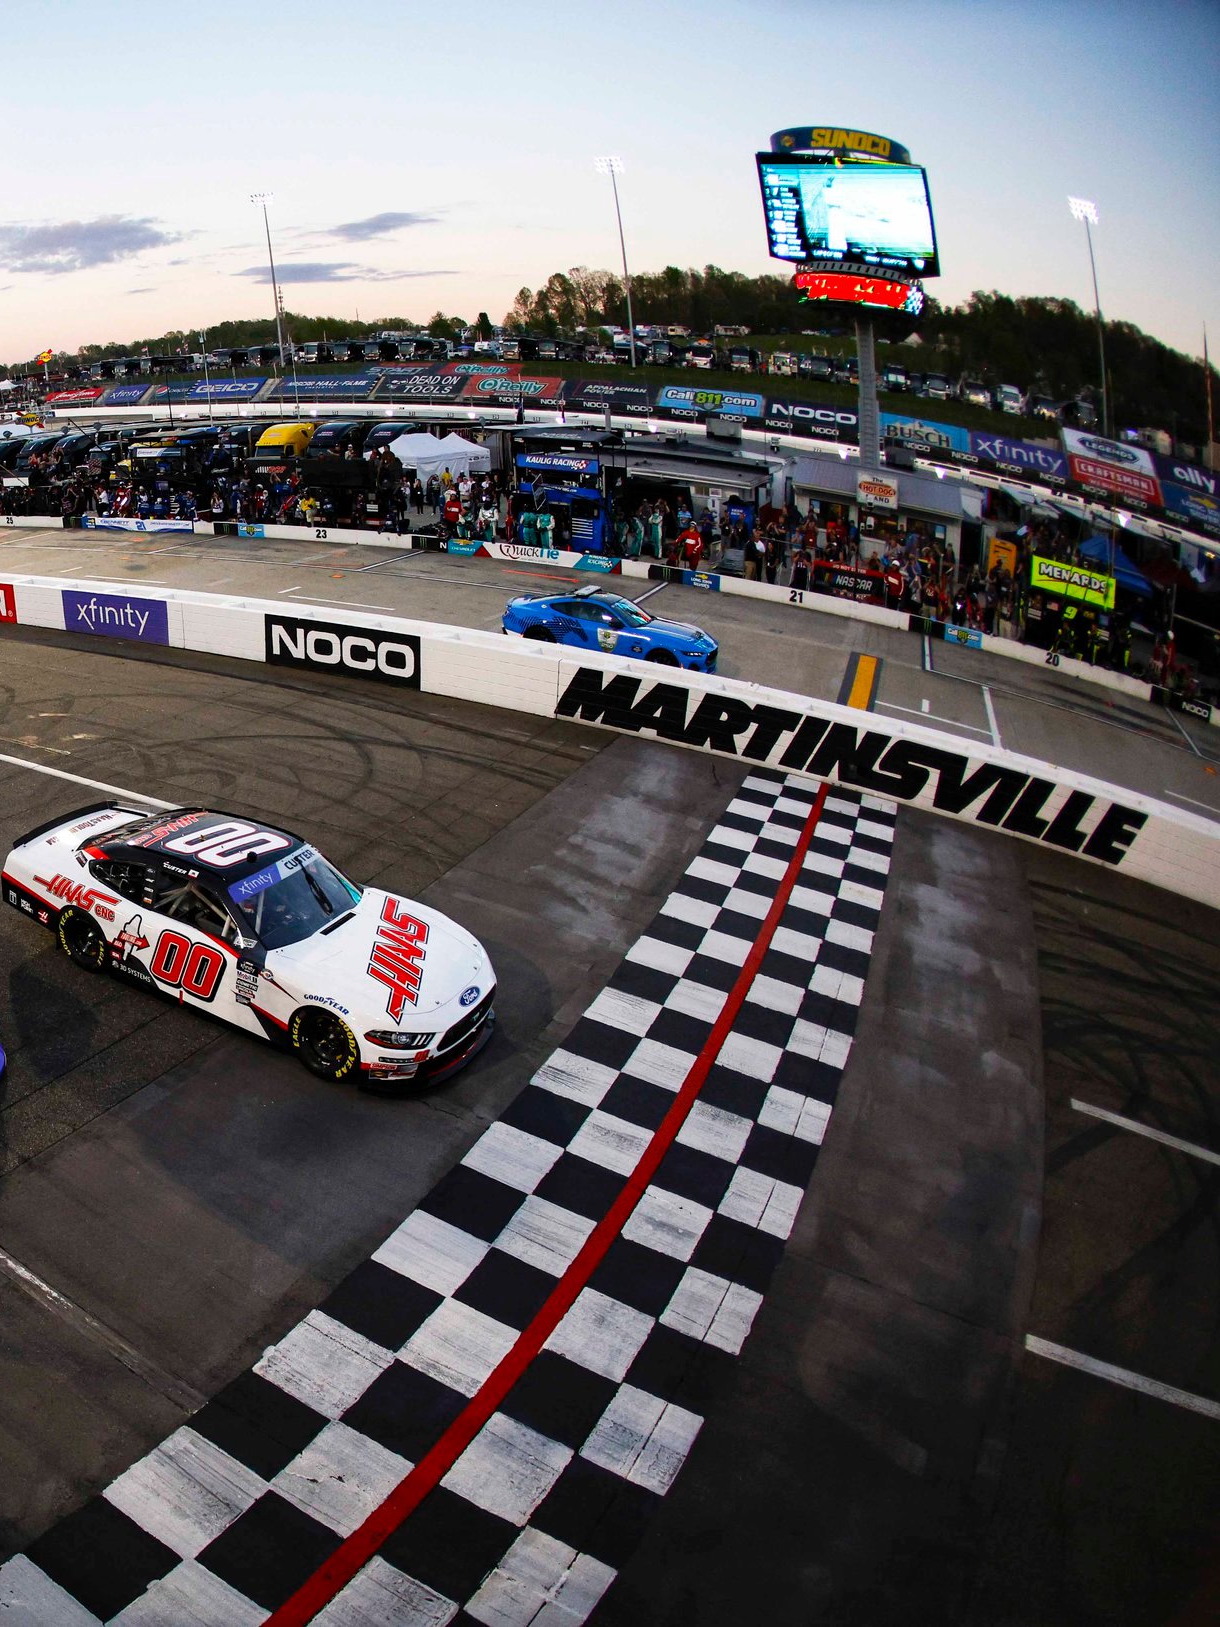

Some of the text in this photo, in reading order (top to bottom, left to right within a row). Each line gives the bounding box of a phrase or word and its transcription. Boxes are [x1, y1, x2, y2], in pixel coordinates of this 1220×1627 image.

[811, 128, 891, 157] SUNOCO
[195, 382, 259, 394] GEICO
[407, 375, 461, 385] DEAD ON
[478, 377, 546, 395] O'Reilly
[586, 384, 647, 394] APPALACHIAN
[110, 388, 144, 400] xfinity
[403, 386, 454, 394] TOOLS
[666, 388, 757, 408] Call811.com
[583, 401, 609, 409] NOCO
[626, 404, 653, 413] NOCO
[671, 408, 698, 417] NOCO
[771, 403, 857, 425] NOCO
[720, 413, 747, 423] NOCO
[765, 419, 793, 429] NOCO
[811, 425, 839, 436] NOCO
[886, 424, 951, 448] BUSCH
[525, 456, 580, 469] KAULIG RACING
[976, 438, 1063, 473] xfinity
[1080, 462, 1149, 490] CRAFTSMAN
[1173, 467, 1215, 495] ally
[863, 484, 894, 496] HOT DOG
[315, 528, 328, 539] 23
[1039, 562, 1109, 592] MENARDS
[789, 590, 804, 604] 21
[77, 598, 150, 636] xfinity
[1063, 606, 1078, 620] 9
[272, 625, 415, 679] NOCO
[1045, 652, 1060, 667] 20
[1182, 701, 1209, 717] NOCO
[555, 667, 1150, 866] MARTINSVILLE
[163, 821, 293, 868] 00
[284, 849, 315, 870] CUSTER
[164, 863, 188, 876] CUSTER
[33, 872, 122, 912] HAAS
[238, 871, 274, 896] xfinity
[94, 904, 116, 922] CNC
[150, 928, 228, 1003] 00
[367, 896, 431, 1026] HAAS
[127, 964, 151, 984] SYSTEMS
[237, 970, 252, 980] Mobil
[303, 993, 350, 1016] GOODYEAR
[462, 988, 478, 1005] Ford
[292, 1016, 302, 1048] EAGLE
[336, 1017, 358, 1078] GOODYEAR
